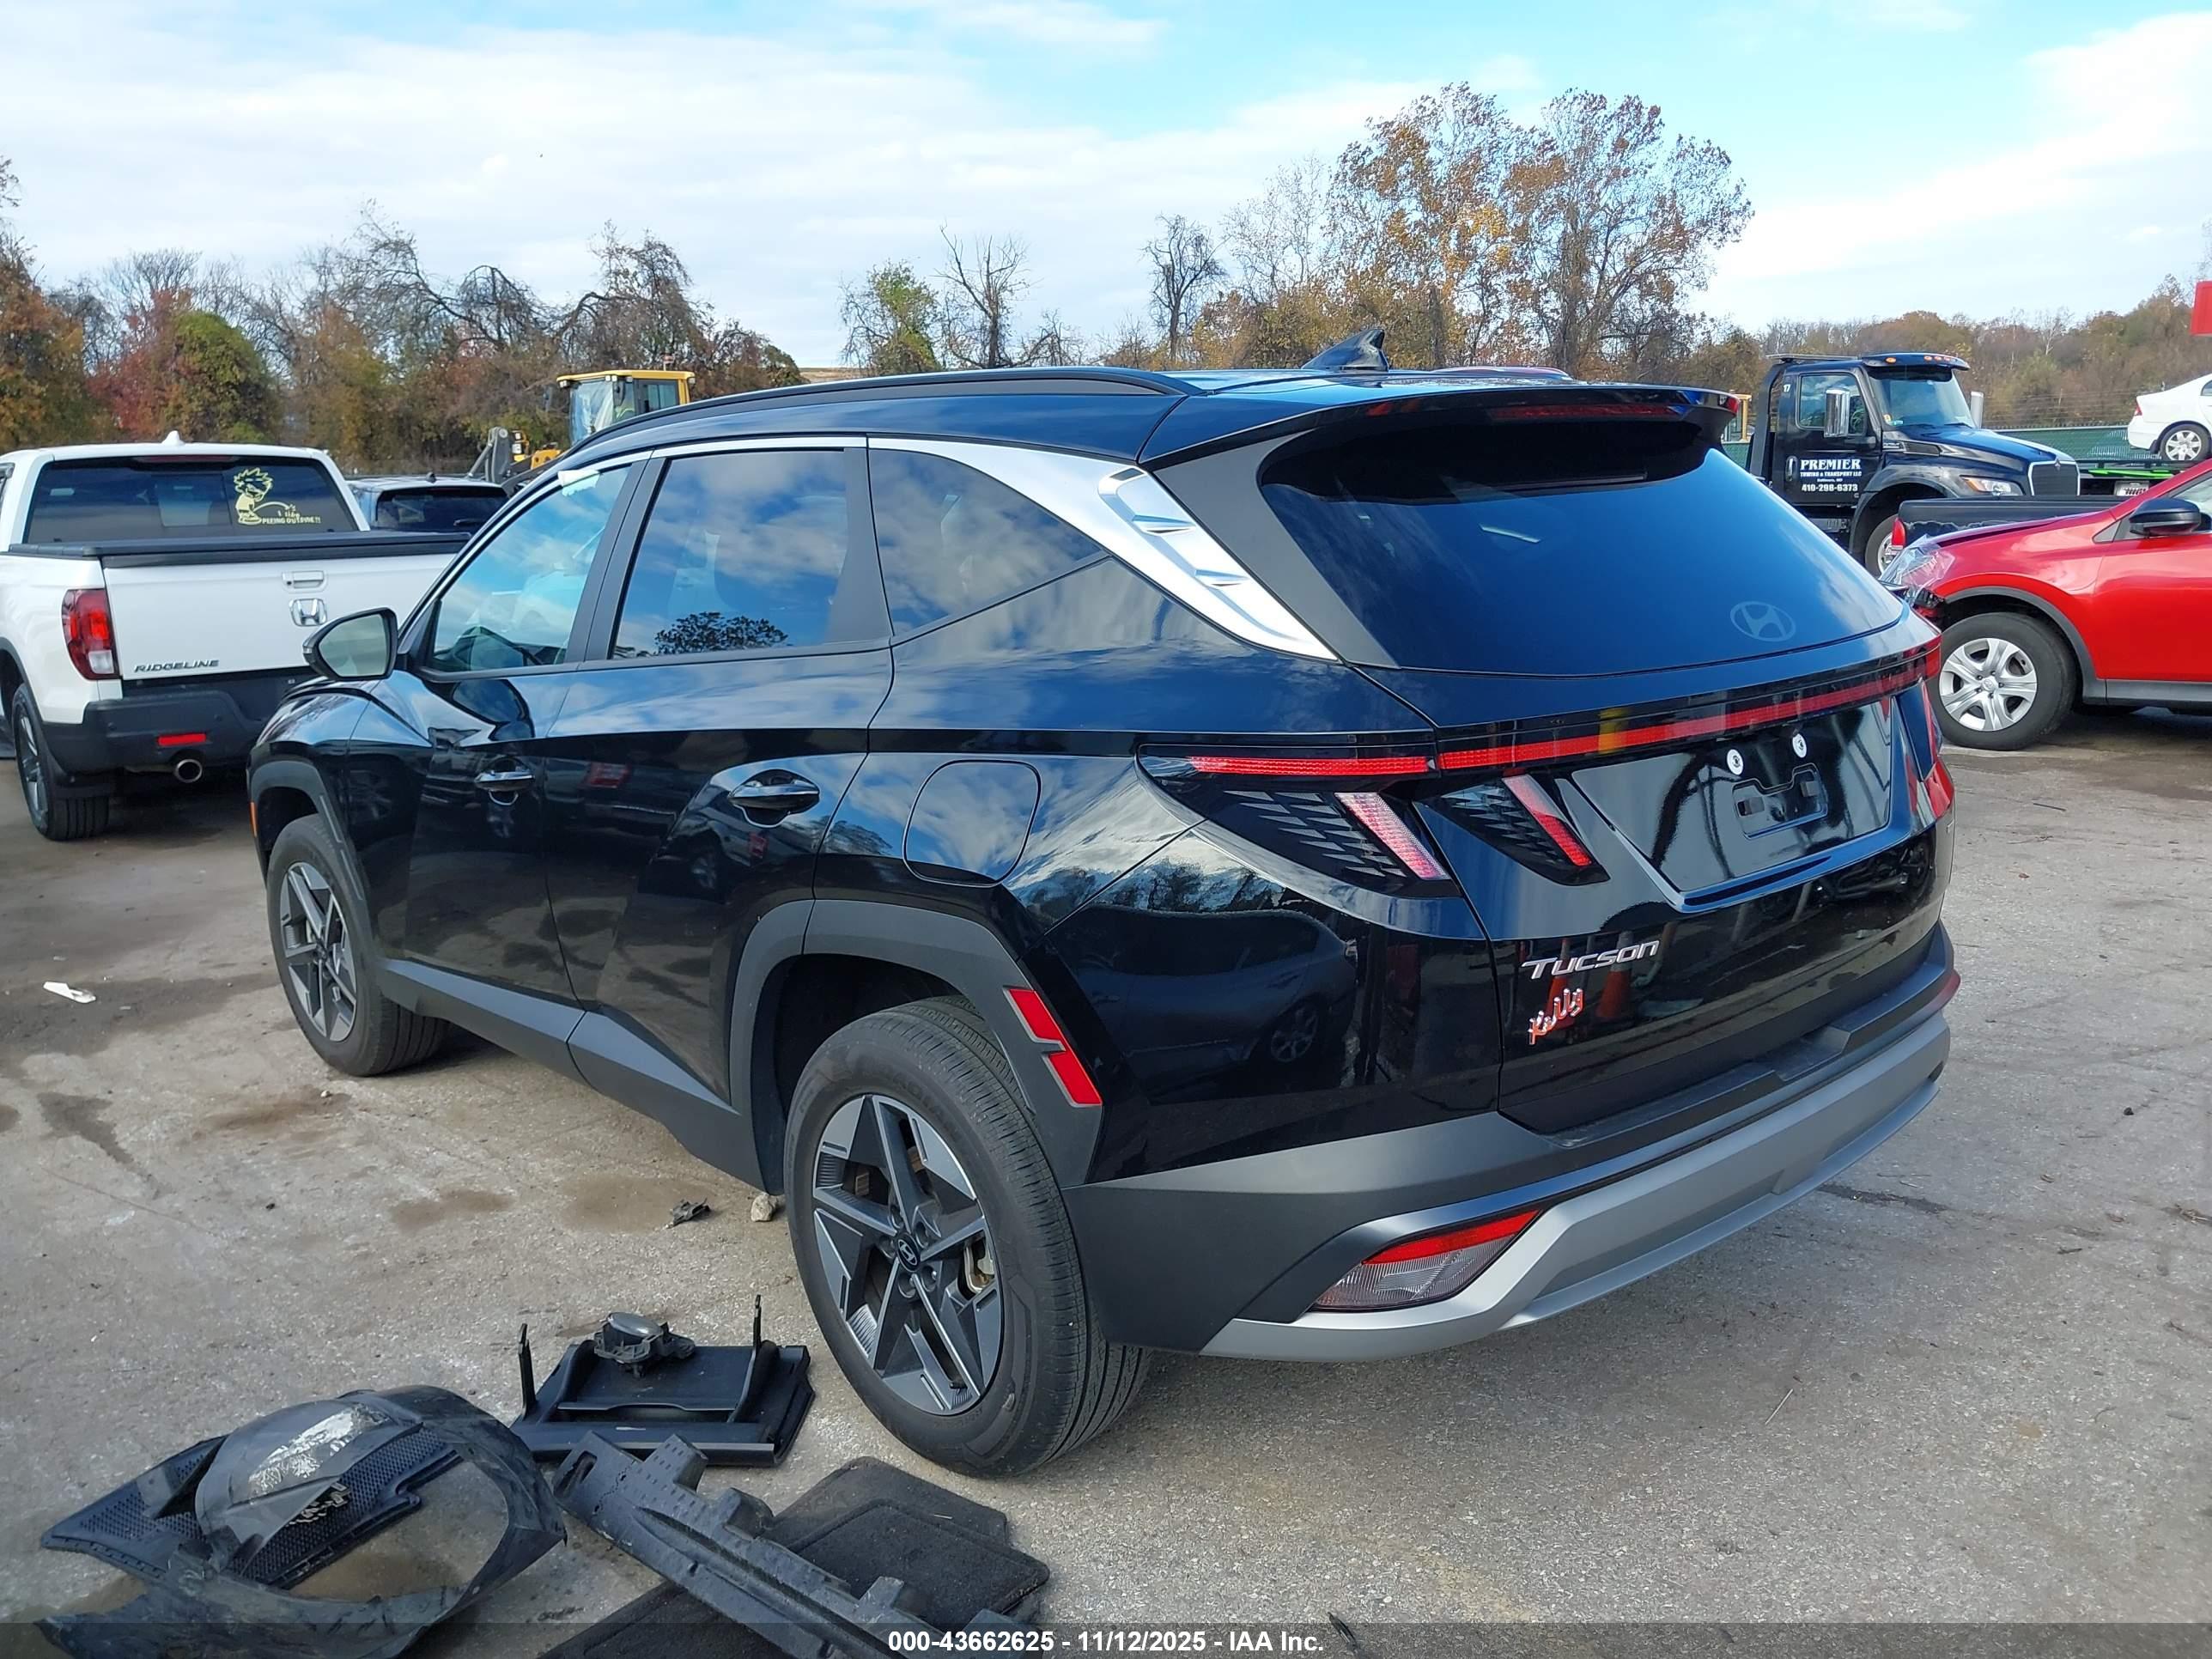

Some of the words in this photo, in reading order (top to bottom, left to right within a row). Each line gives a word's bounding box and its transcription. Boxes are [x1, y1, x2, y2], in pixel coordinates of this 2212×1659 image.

[1783, 384, 1791, 392] 17
[1800, 459, 1862, 471] PREMIER
[1801, 483, 1858, 492] 410-298-6373
[134, 659, 220, 673] RIDGELINE
[1528, 988, 1583, 1046] Kelly
